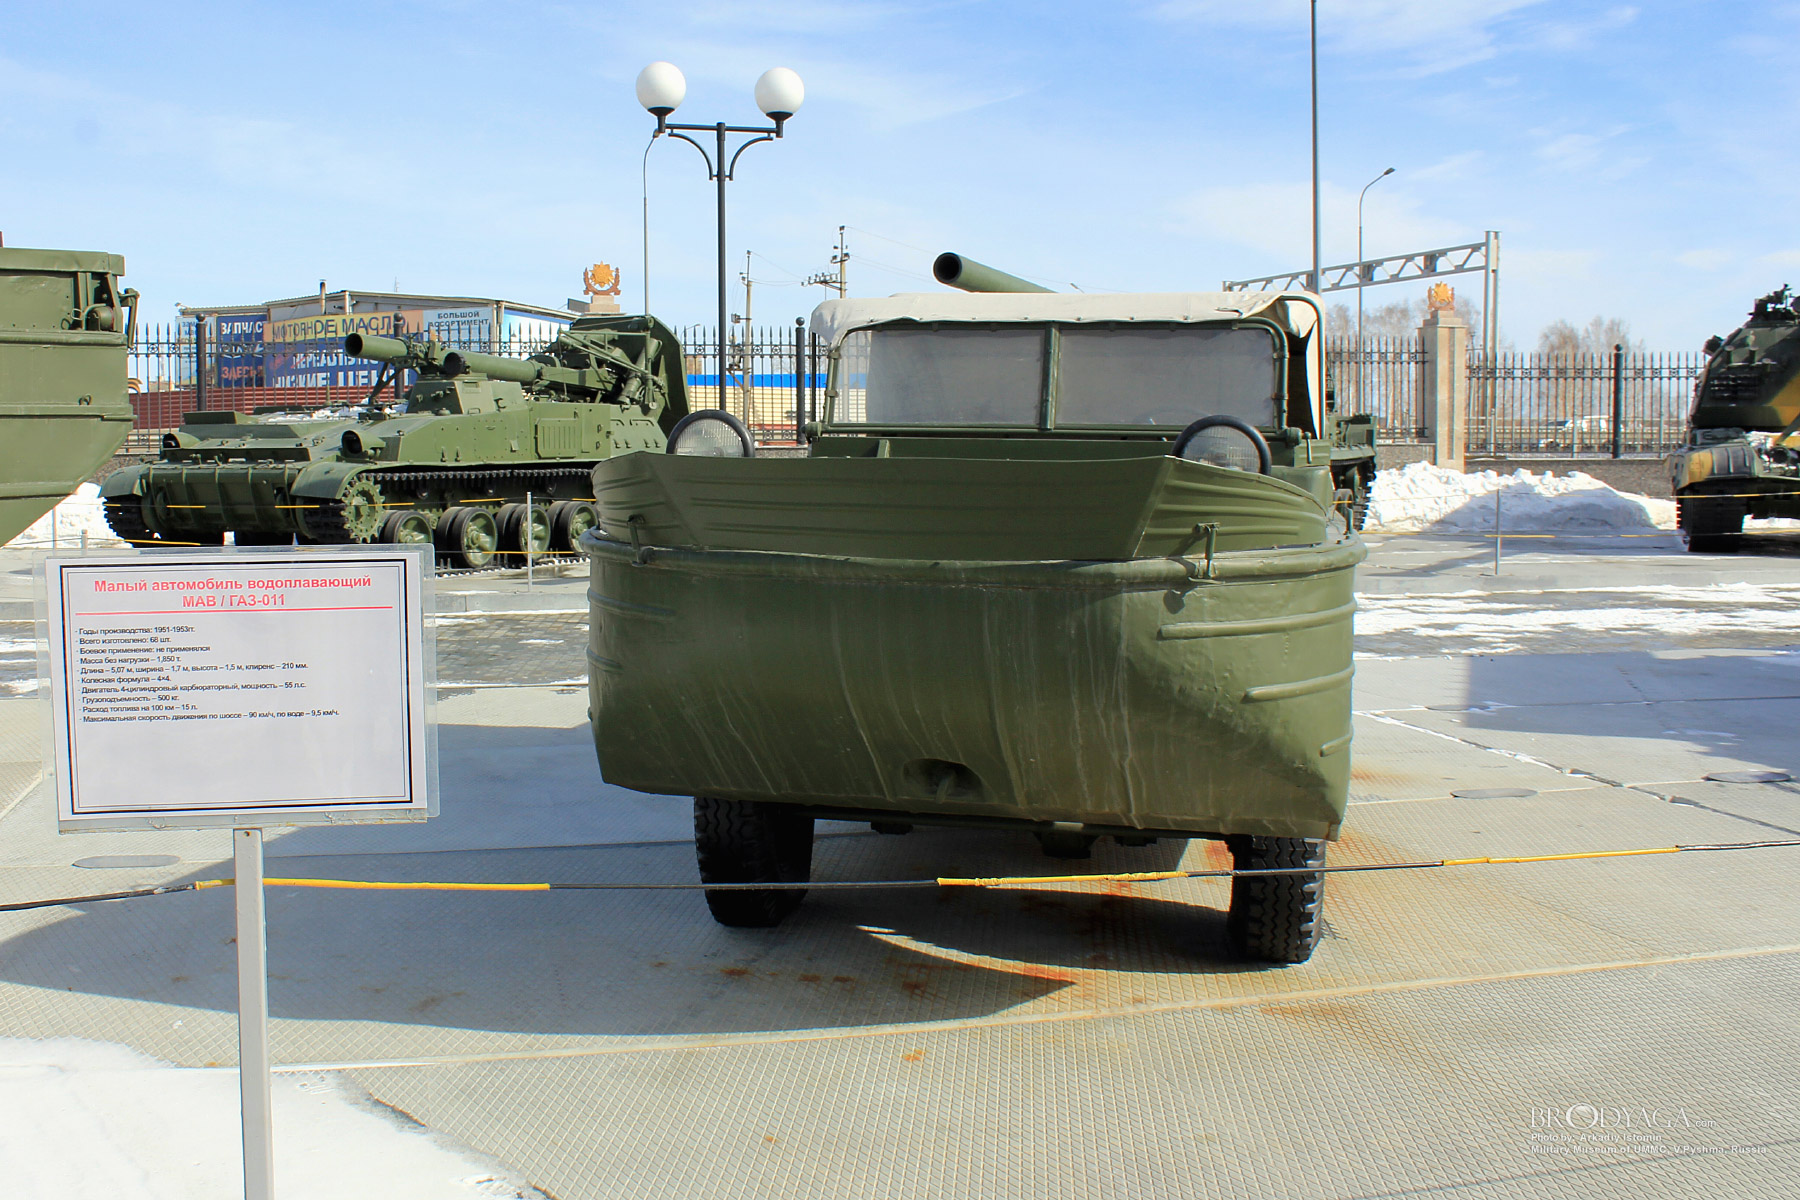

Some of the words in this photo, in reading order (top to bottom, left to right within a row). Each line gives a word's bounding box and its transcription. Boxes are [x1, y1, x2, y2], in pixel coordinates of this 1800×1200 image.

[438, 311, 480, 319] БОЛЬШОЙ
[220, 321, 265, 334] ЗАПЧАС
[429, 319, 489, 328] АССОРТИМЕНТ
[94, 580, 147, 592] Малый
[152, 578, 242, 590] автомобиль
[248, 575, 371, 590] водоплавающий
[182, 595, 216, 608] МАВ
[230, 594, 285, 606] ГАЗ-011
[100, 627, 152, 635] производства:
[121, 685, 178, 693] 4-цилиндровый
[180, 683, 240, 691] карбюраторный,
